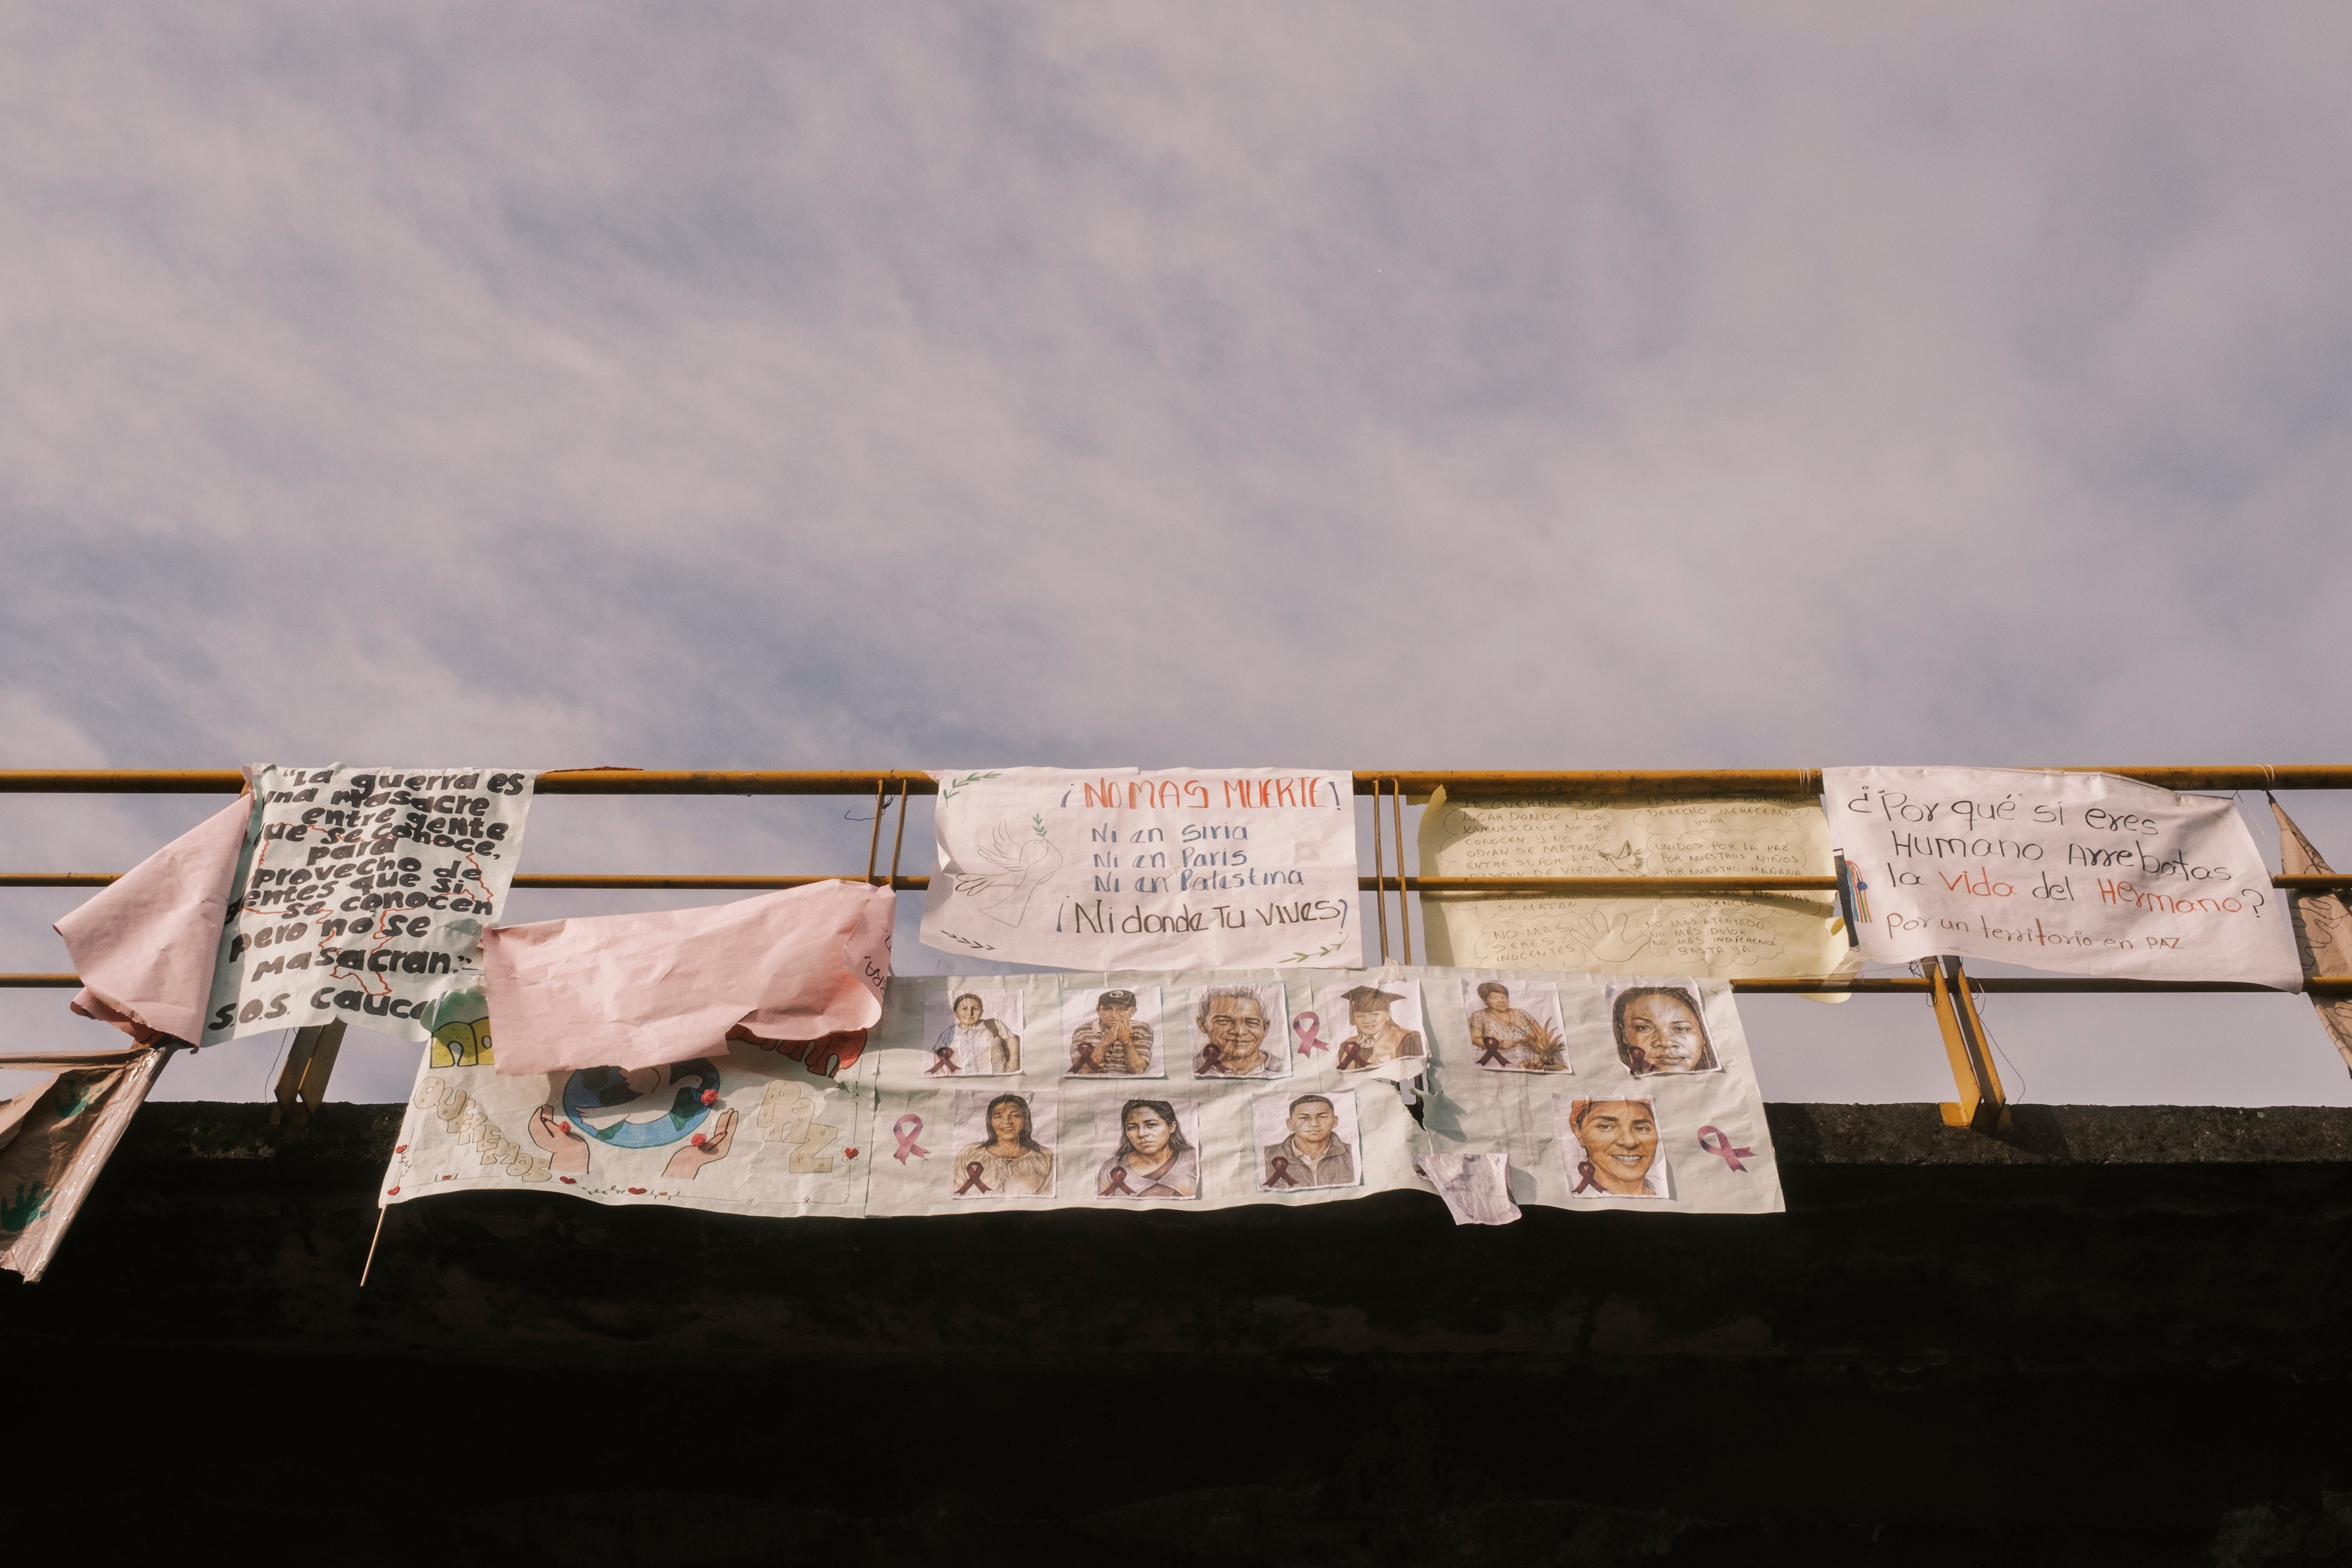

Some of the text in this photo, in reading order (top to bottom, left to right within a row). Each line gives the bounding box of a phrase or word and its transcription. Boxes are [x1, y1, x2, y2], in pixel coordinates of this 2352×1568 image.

[351, 773, 479, 800] guerra
[487, 773, 525, 795] es
[1224, 777, 1341, 810] MUERTE!
[331, 790, 490, 816] masacre
[1491, 798, 1556, 809] GUERRA
[1647, 806, 1801, 817] DERECHO MERECEMOS
[302, 807, 509, 841] entre gente
[1462, 811, 1503, 821] LUGAR
[1510, 812, 1561, 820] DONDE
[2085, 808, 2158, 835] eres
[1092, 823, 1117, 843] Ni
[1462, 825, 1517, 834] JOVENES
[306, 837, 399, 866] para
[320, 827, 363, 844] se
[371, 823, 501, 859] conoce,
[1467, 848, 1509, 857] ODIAN
[1543, 844, 1596, 853] MATAN
[1711, 842, 1738, 851] POR
[1743, 842, 1758, 851] LA
[1094, 851, 1118, 868] Ni
[1182, 847, 1247, 868] Paris
[1467, 860, 1509, 869] ENTRE
[1661, 852, 1799, 863] POR NUESTROS NIÑOS
[2069, 840, 2232, 881] Arrebatas
[251, 857, 482, 889] provecho de
[1094, 872, 1120, 892] Ni
[1181, 868, 1305, 891] Palestina
[1559, 866, 1609, 875] VIEJOS
[1664, 866, 1802, 876] POR NUESTRO MAÑANA
[350, 872, 421, 896] que
[430, 878, 464, 894] si
[1887, 862, 1925, 888] la
[2032, 871, 2074, 901] del
[2098, 878, 2264, 918] Hermano?
[281, 891, 493, 919] se conocen
[1783, 893, 1810, 902] MAS
[1494, 925, 1570, 939] NO MAS
[1704, 918, 1764, 930] ATENTADO
[1941, 918, 1969, 932] un
[1981, 915, 2092, 946] territorio
[2103, 938, 2134, 949] en
[2146, 937, 2185, 949] PAZ
[229, 915, 430, 963] pero no se
[1493, 938, 1554, 953] SERES
[1497, 945, 1576, 962] INOCENTES
[1677, 947, 1724, 955] BASTA
[208, 993, 291, 1030] S.O.S.
[413, 1076, 552, 1182] QUEREMOS
[757, 1079, 839, 1173] PAZ
